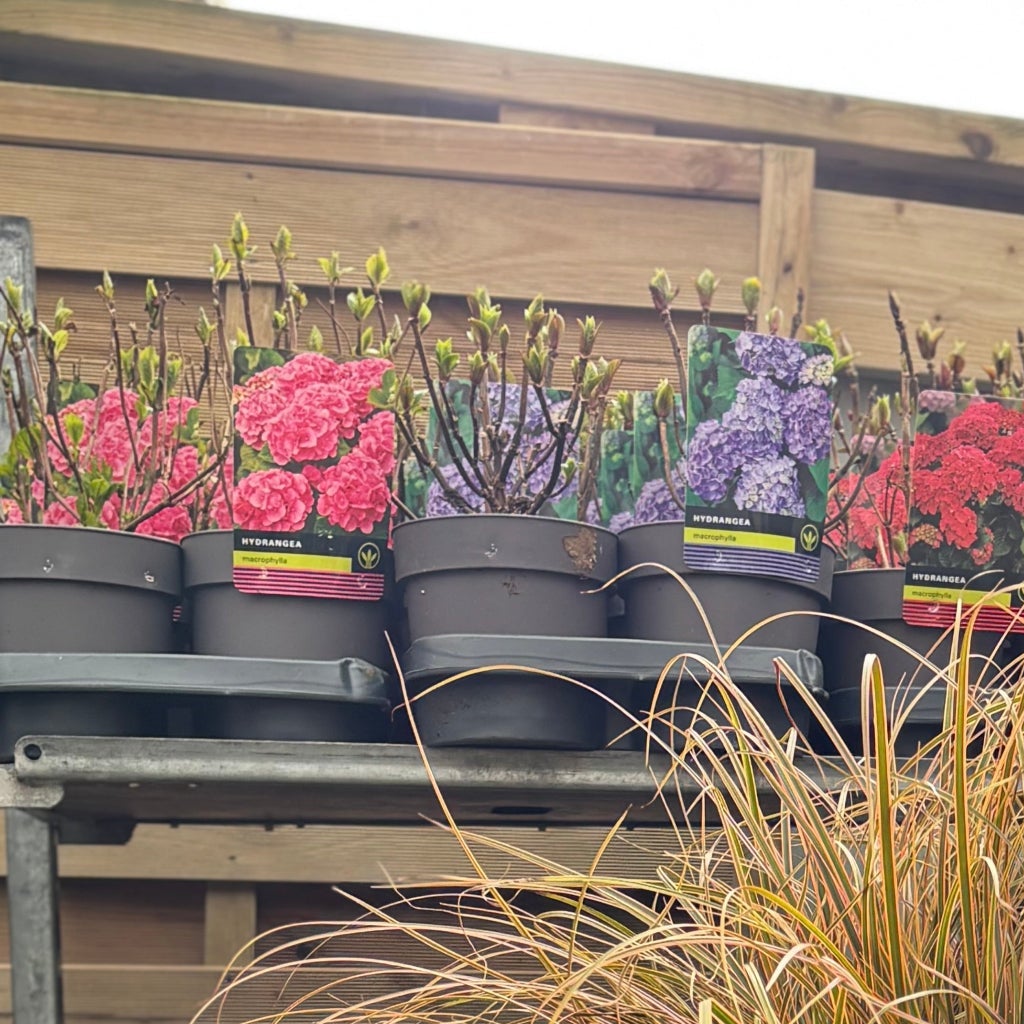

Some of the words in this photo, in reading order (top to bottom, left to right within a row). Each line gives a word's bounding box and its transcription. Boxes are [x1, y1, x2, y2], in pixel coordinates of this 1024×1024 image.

[693, 514, 751, 526] HYDRANGEA
[693, 532, 737, 542] macrophylla
[241, 537, 302, 549] HYDRANGEA
[242, 555, 288, 565] macrophylla
[912, 573, 966, 584] HYDRANGEA
[912, 590, 952, 600] macrophylla
